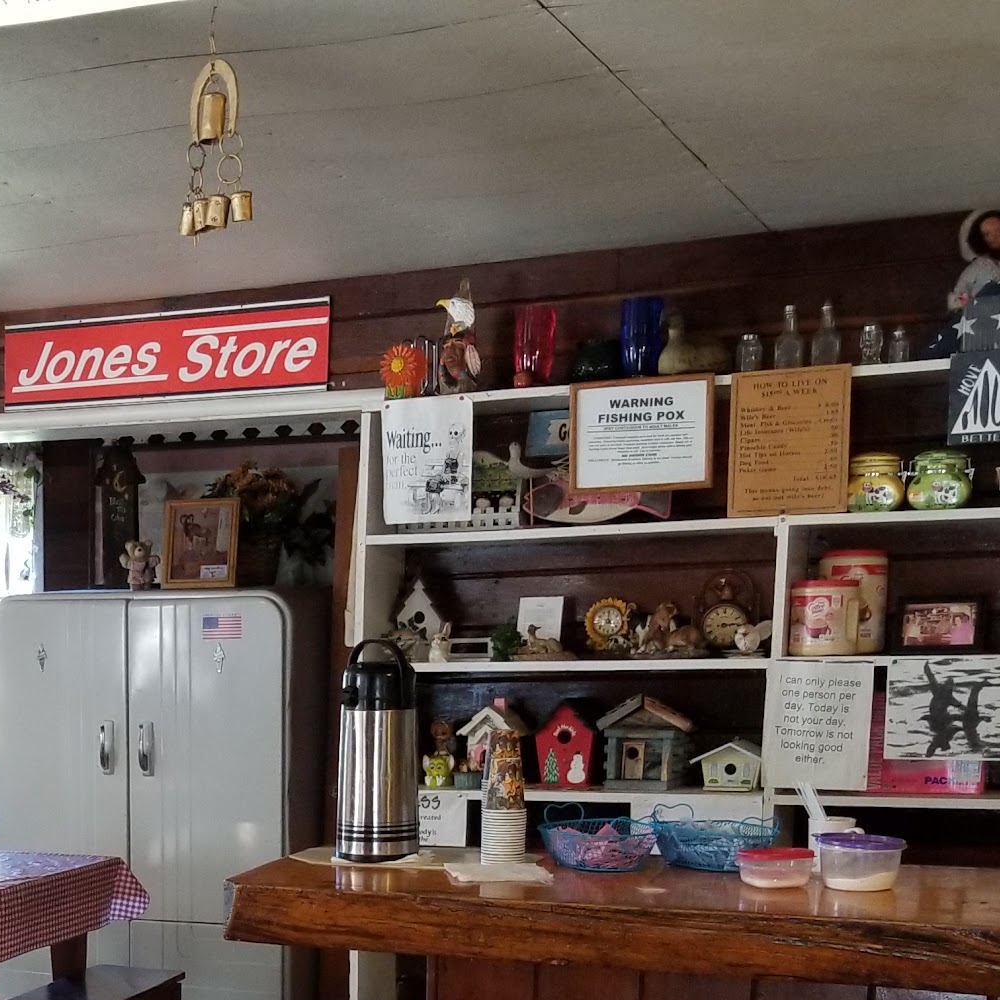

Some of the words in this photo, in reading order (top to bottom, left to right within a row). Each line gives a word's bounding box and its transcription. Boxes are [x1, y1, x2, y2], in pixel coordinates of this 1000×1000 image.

[18, 341, 161, 386] Jones
[178, 335, 318, 383] Store
[753, 382, 772, 390] HOW
[609, 396, 674, 409] WARNING
[598, 412, 652, 424] FISHING
[656, 410, 685, 421] POX
[386, 427, 442, 454] Waiting...
[386, 455, 398, 465] for
[400, 452, 416, 465] the
[386, 464, 418, 479] perfect
[806, 677, 826, 688] only
[828, 678, 862, 689] please
[782, 689, 800, 698] one
[802, 691, 836, 700] person
[838, 692, 856, 702] per
[784, 702, 804, 712] day.
[808, 702, 838, 715] Today
[841, 704, 850, 714] is
[784, 715, 800, 724] not
[802, 717, 824, 726] your
[825, 716, 846, 728] day.
[774, 726, 824, 739] Tomorrow
[826, 730, 834, 739] is
[837, 731, 854, 740] not
[780, 740, 815, 753] looking
[818, 743, 843, 754] good
[795, 754, 825, 765] either.
[418, 795, 440, 810] SS
